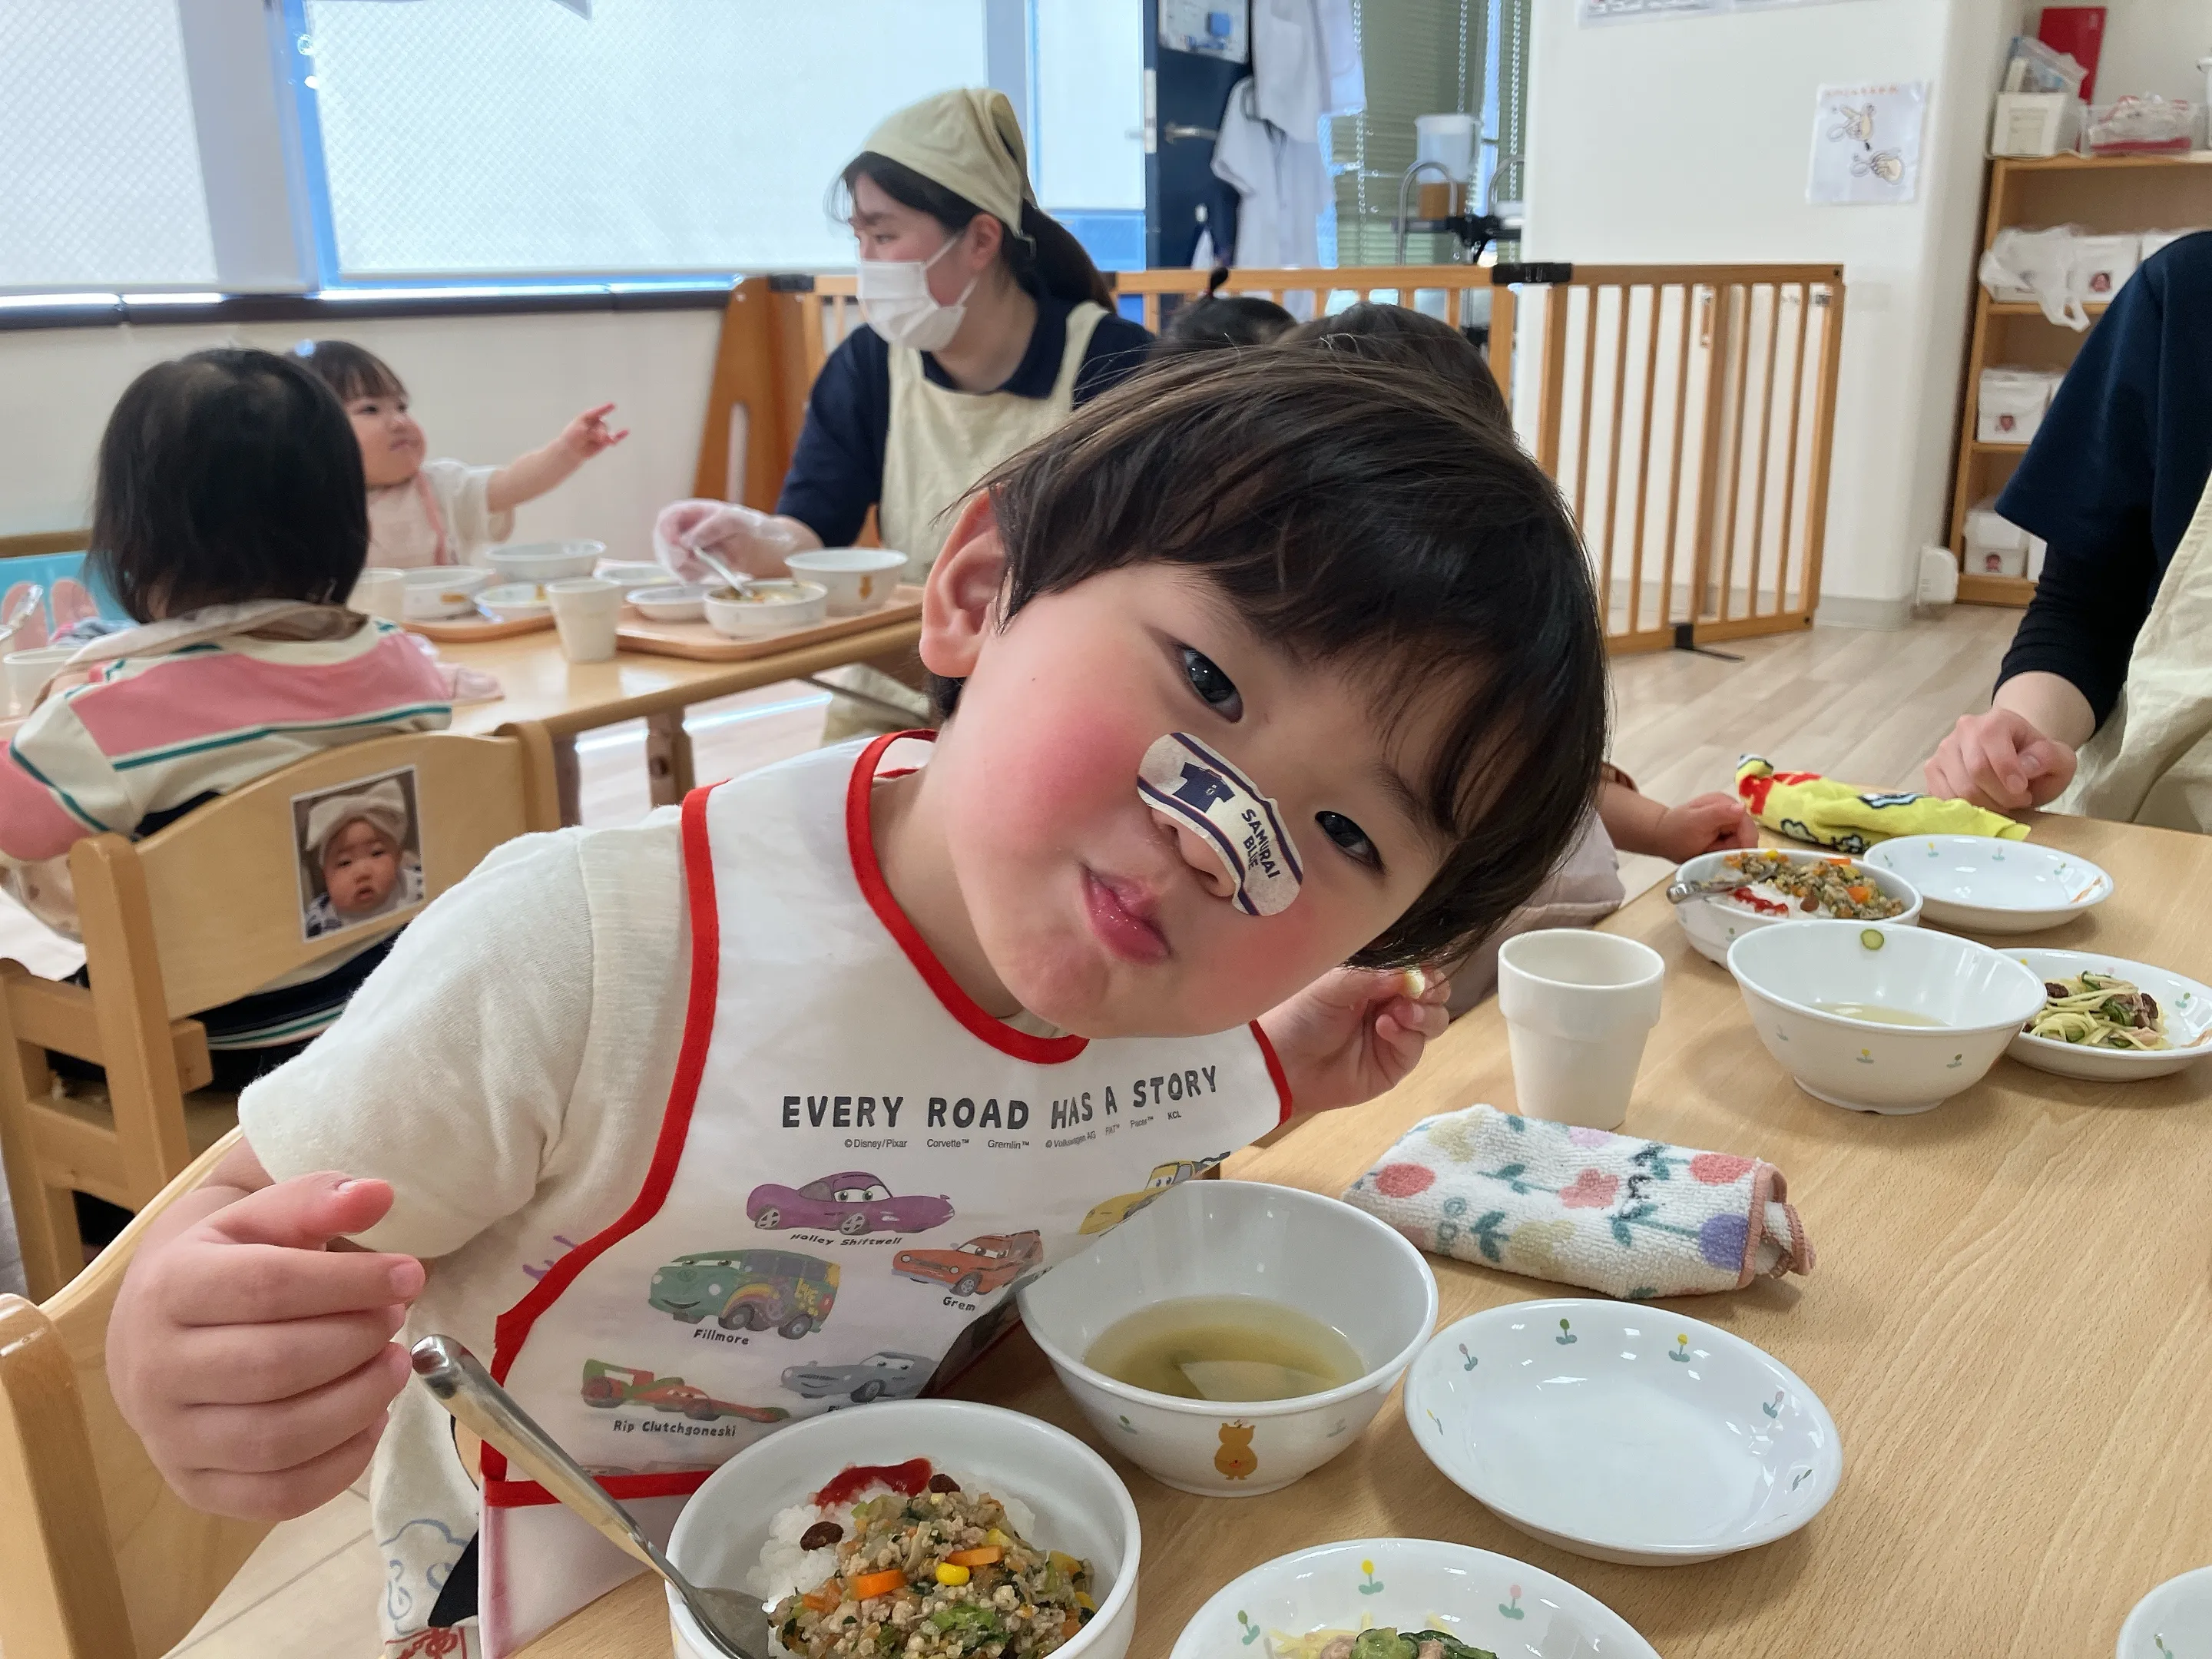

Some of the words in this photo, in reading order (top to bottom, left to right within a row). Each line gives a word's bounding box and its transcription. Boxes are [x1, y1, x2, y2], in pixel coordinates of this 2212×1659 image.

[1241, 809, 1280, 878] SAMURAI
[1243, 836, 1259, 870] BLUE
[782, 1095, 904, 1128] EVERY
[927, 1097, 1029, 1130] ROAD
[1050, 1091, 1093, 1130] HAS
[1104, 1085, 1118, 1115] A
[1133, 1065, 1217, 1108] STORY
[1167, 1110, 1182, 1121] KCL
[790, 1233, 834, 1246] Holley
[839, 1237, 903, 1247] Shiftwell
[942, 1296, 976, 1312] Grem
[693, 1328, 750, 1345] Fillmore
[613, 1420, 635, 1433] Rip
[642, 1421, 736, 1437] Clutchgoneski
